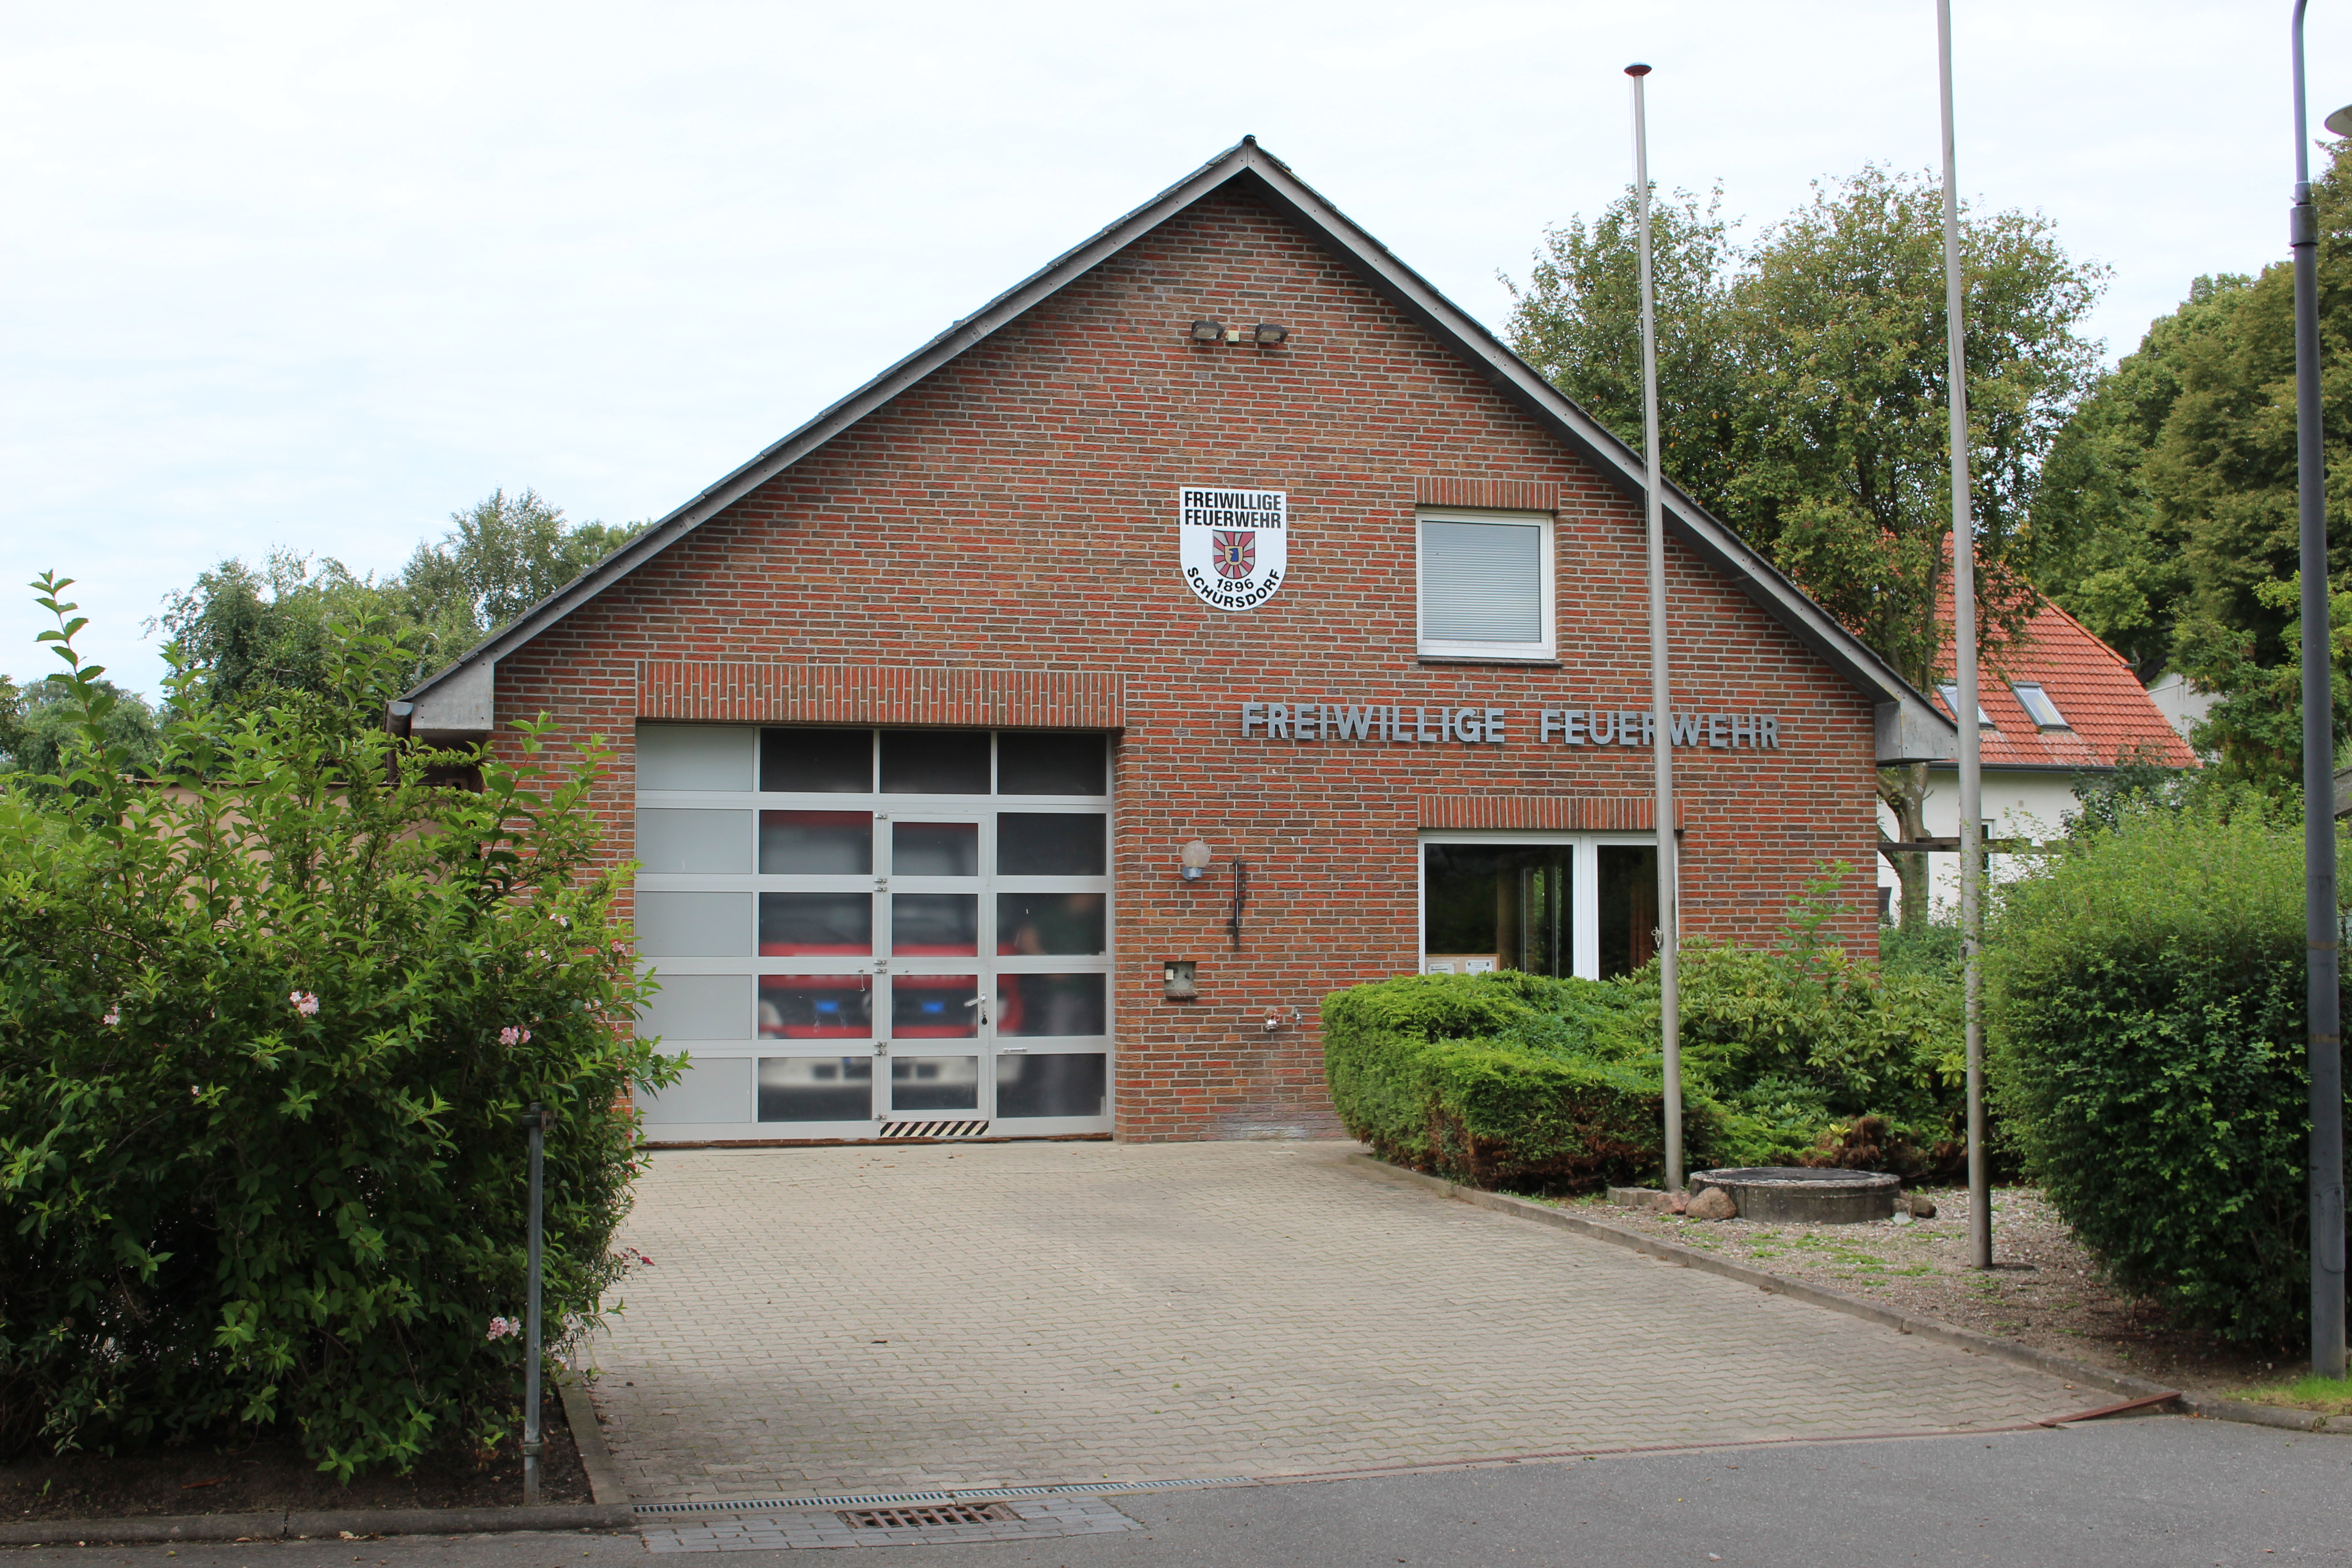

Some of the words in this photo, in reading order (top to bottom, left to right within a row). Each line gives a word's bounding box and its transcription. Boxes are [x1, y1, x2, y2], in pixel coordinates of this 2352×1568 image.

[1185, 491, 1281, 511] FREIWILLIGE
[1185, 509, 1281, 529] FEUERWEHR
[1187, 567, 1280, 608] SCHÜRSDORF
[1216, 578, 1254, 593] 1896
[1242, 703, 1504, 742] FREIWILLIGE
[1541, 710, 1779, 748] FEUERWEHR
